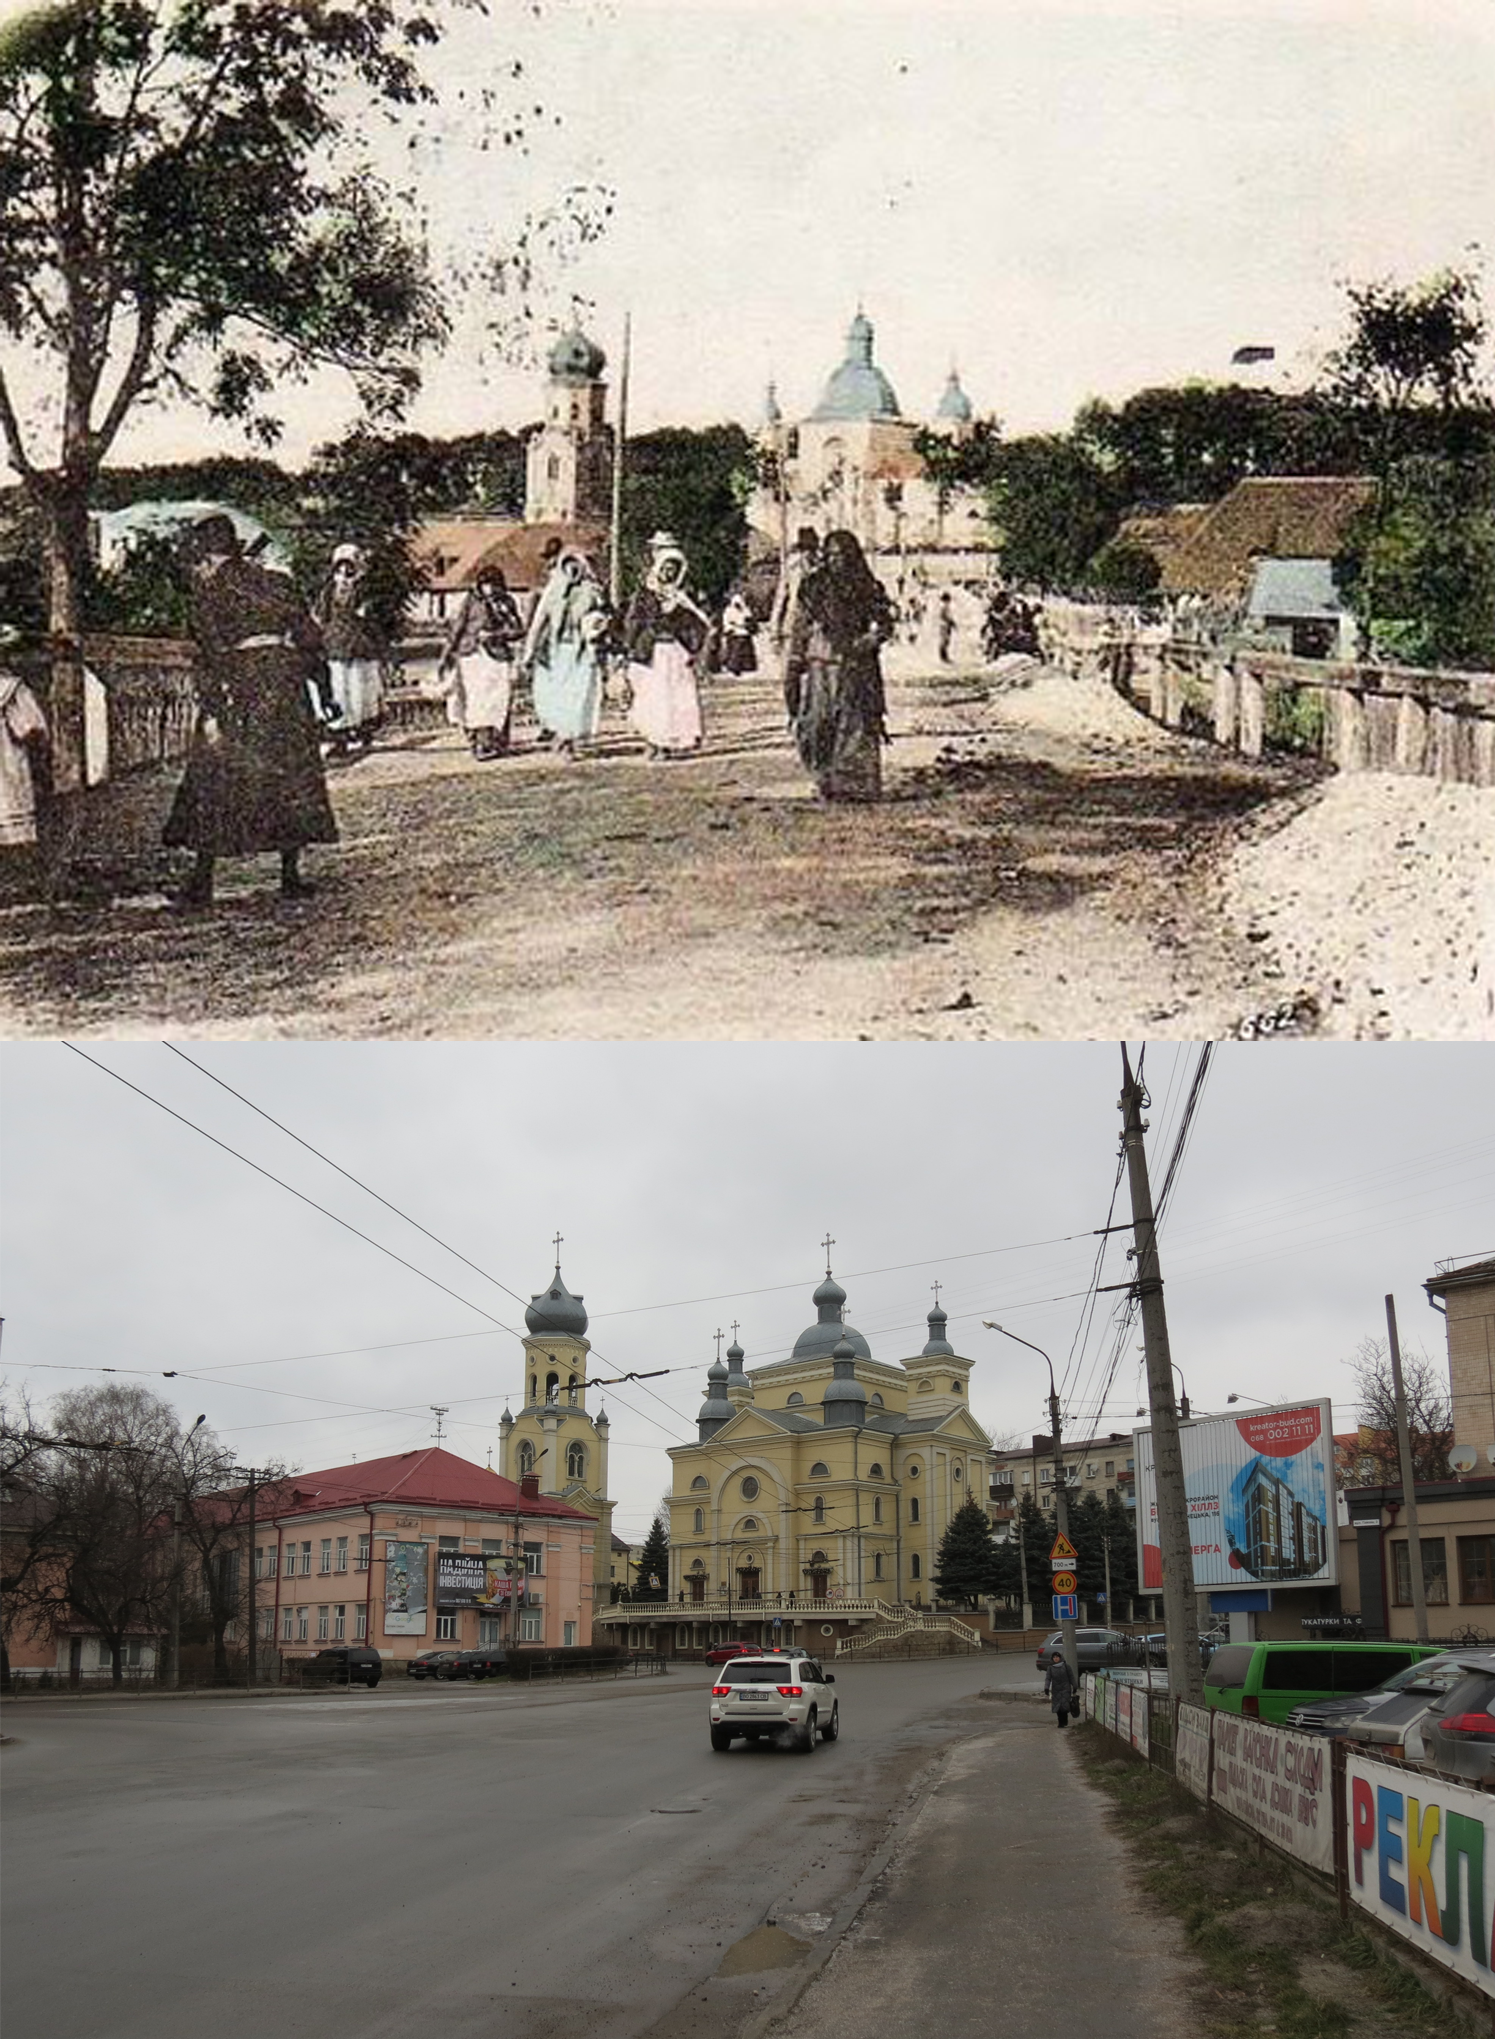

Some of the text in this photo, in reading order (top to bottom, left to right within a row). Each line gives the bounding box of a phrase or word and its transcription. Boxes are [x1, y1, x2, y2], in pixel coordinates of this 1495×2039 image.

[1249, 1416, 1313, 1431] kreator-bud.com
[1250, 1434, 1264, 1442] 068
[1267, 1428, 1289, 1439] 002
[1292, 1426, 1301, 1436] 11
[1305, 1424, 1314, 1434] 11
[1186, 1494, 1219, 1503] КРОРАЙОН
[1190, 1501, 1219, 1512] ХІЛЛЗ
[440, 1557, 484, 1576] НАДІЙНА
[439, 1575, 484, 1589] ІНВЕСТИЦІЯ
[1057, 1577, 1072, 1588] 40
[1243, 1728, 1279, 1776] ВАГОНКА
[1352, 1775, 1495, 1974] РЕКЛ
